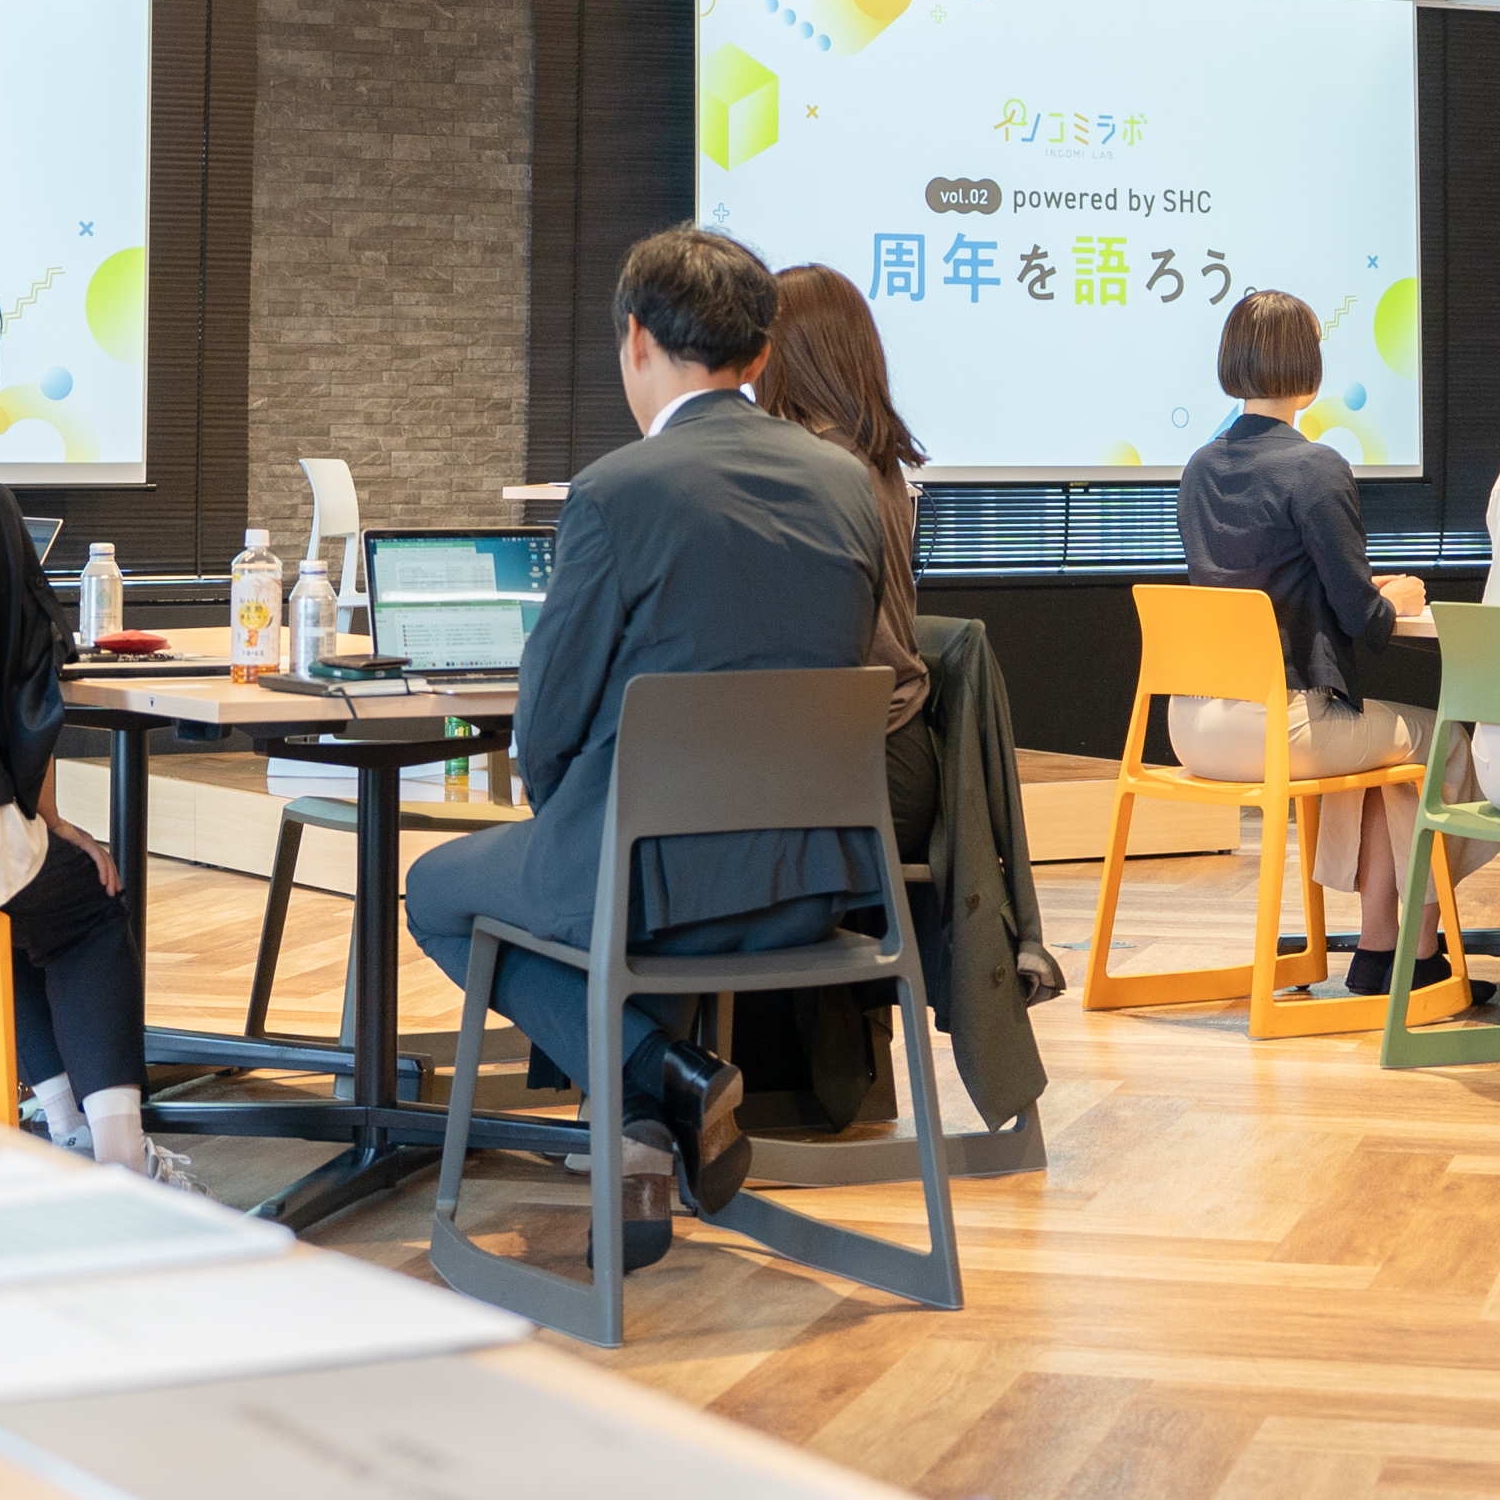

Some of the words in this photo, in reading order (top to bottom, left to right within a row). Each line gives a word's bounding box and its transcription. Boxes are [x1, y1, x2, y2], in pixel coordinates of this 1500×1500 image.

[1045, 148, 1085, 159] INCOMI
[1092, 150, 1114, 160] LAB
[940, 188, 989, 205] vol.02
[1013, 188, 1118, 214] powered
[1129, 188, 1155, 217] by
[1163, 189, 1211, 213] SHC
